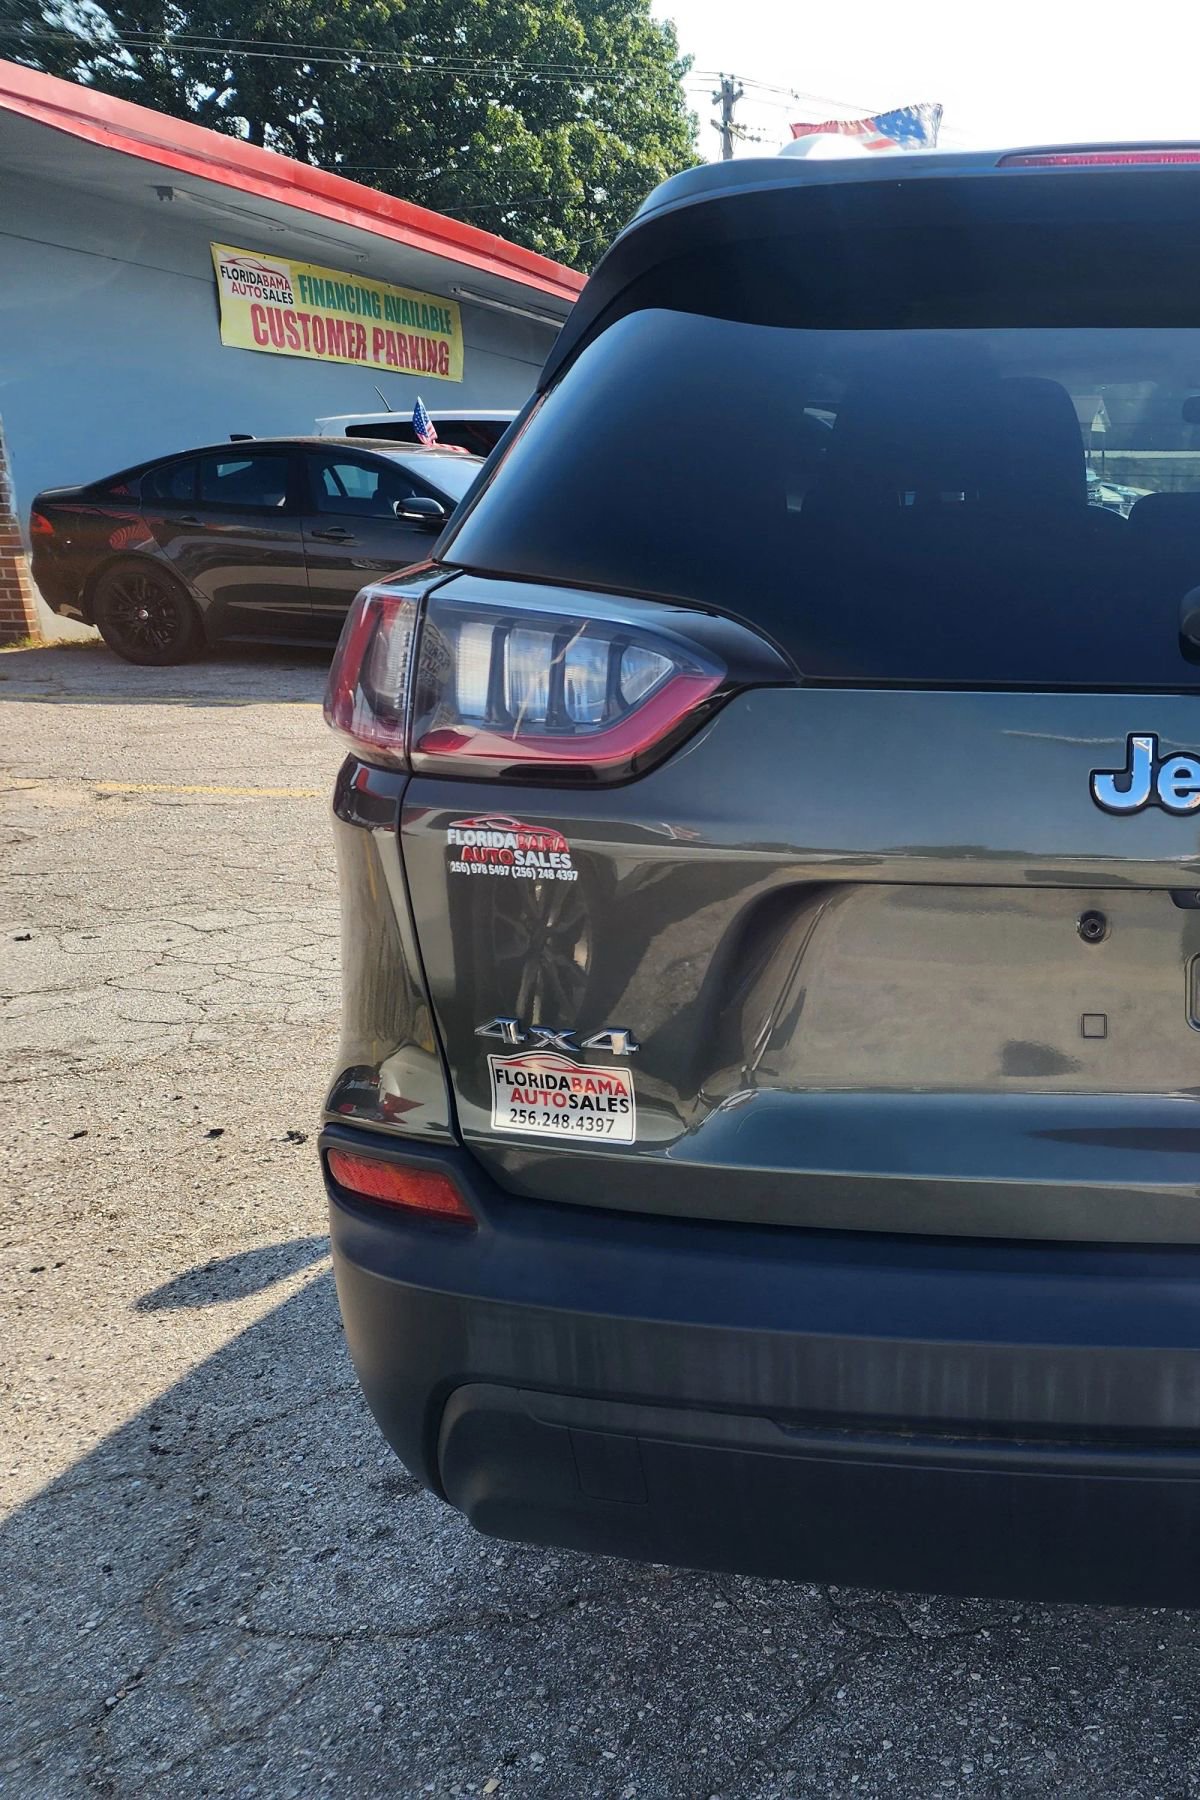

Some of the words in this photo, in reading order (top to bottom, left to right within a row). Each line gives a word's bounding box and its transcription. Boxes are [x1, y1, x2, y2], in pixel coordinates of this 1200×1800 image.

[220, 265, 291, 292] FLORIDABAMA
[298, 274, 382, 320] FINANCING
[384, 294, 453, 335] AVAILABLE
[250, 304, 367, 361] CUSTOMER
[373, 327, 449, 376] PARKING
[447, 829, 570, 852] FLORIDABAMA
[471, 863, 488, 874] 978
[488, 864, 510, 876] 5497
[511, 866, 536, 880] (256)
[537, 868, 555, 880] 248
[556, 869, 578, 881] 4397
[495, 1069, 628, 1096] FLORIDABAMA
[509, 1108, 616, 1133] 256.248.4397
